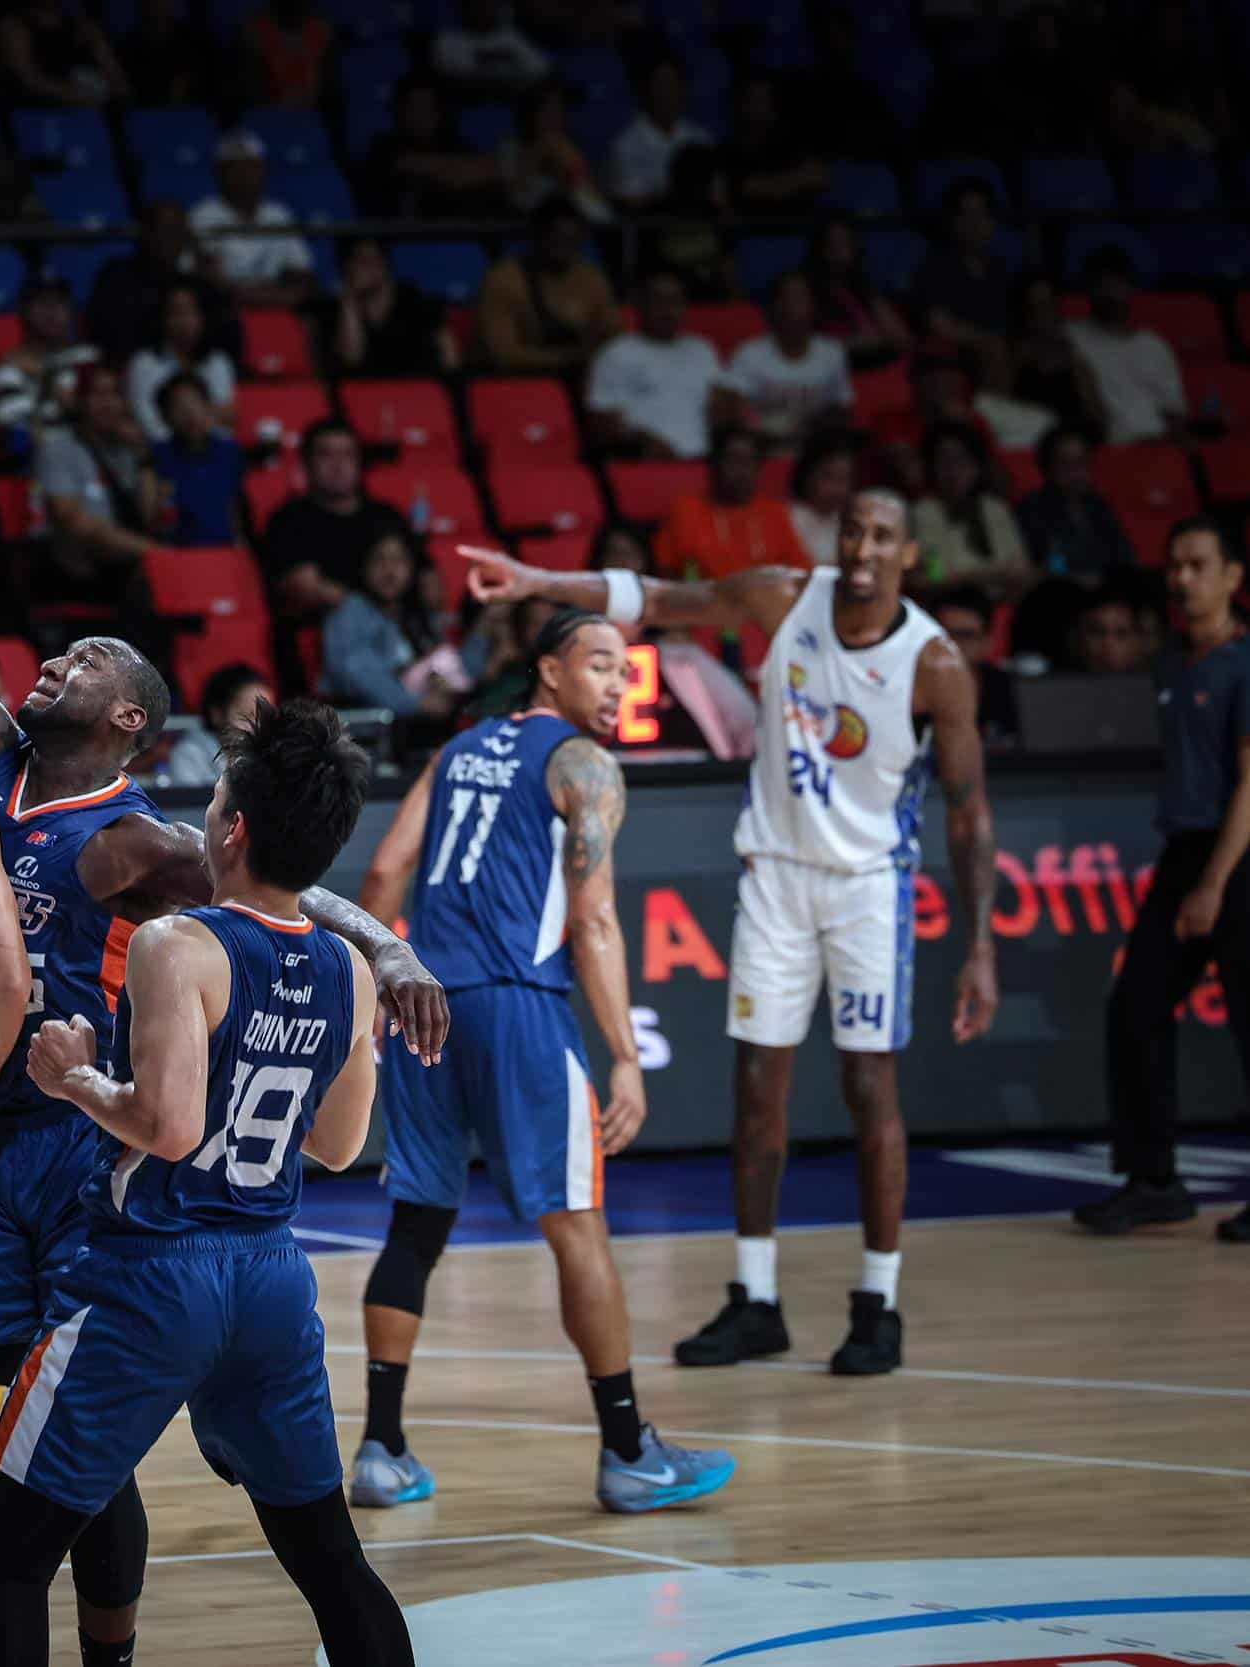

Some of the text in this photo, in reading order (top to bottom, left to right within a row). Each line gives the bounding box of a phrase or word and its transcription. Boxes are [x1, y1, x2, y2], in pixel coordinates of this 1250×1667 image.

[427, 787, 502, 886] 11
[838, 990, 883, 1030] 24
[191, 1058, 314, 1188] 19
